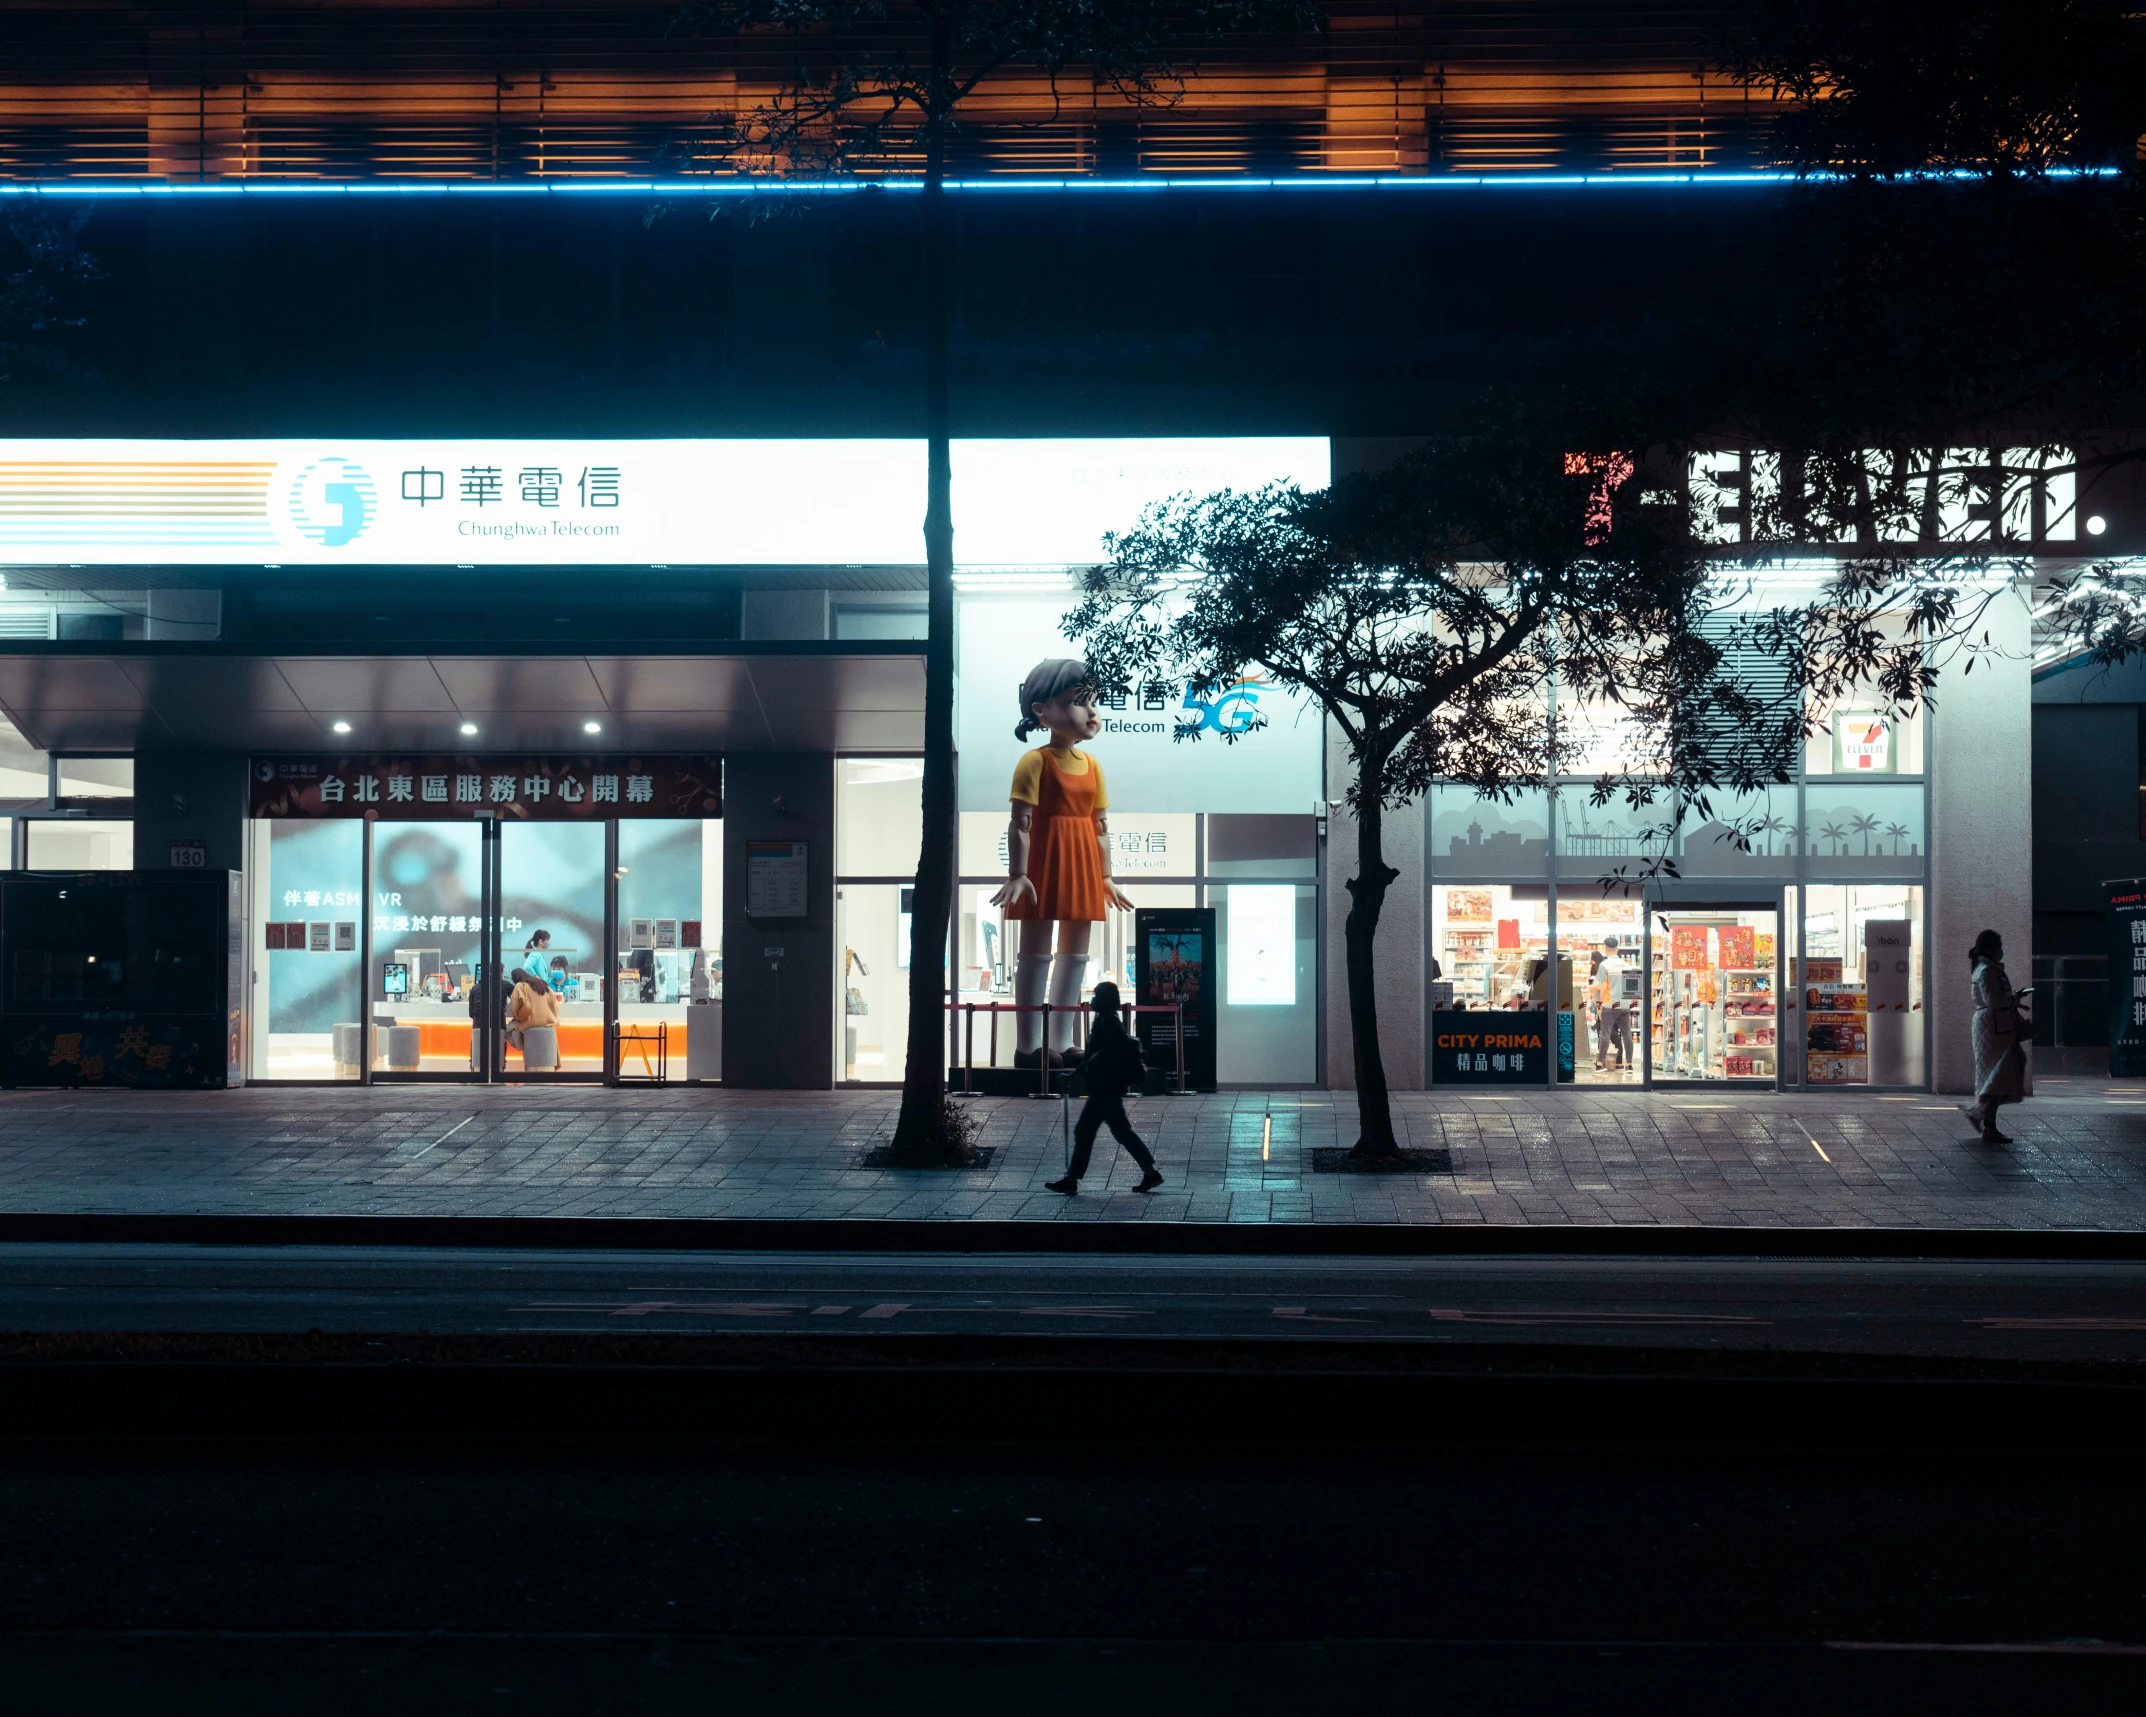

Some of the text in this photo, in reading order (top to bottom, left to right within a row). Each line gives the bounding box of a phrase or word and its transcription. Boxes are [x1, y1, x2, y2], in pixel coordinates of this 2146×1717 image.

[401, 466, 621, 508] 中華電信
[1563, 448, 2077, 546] 7-ELVEn
[458, 520, 620, 541] Chunghwa Telecom
[1174, 681, 1260, 734] 5G
[1102, 718, 1165, 733] Telecom
[279, 763, 318, 773] 中華電信
[319, 773, 655, 804] 台北東區服務中心開幕
[174, 851, 202, 866] 130
[379, 892, 402, 907] VR
[1437, 1034, 1543, 1048] CITY PRIMA
[1456, 1052, 1525, 1071] 精品咖啡
